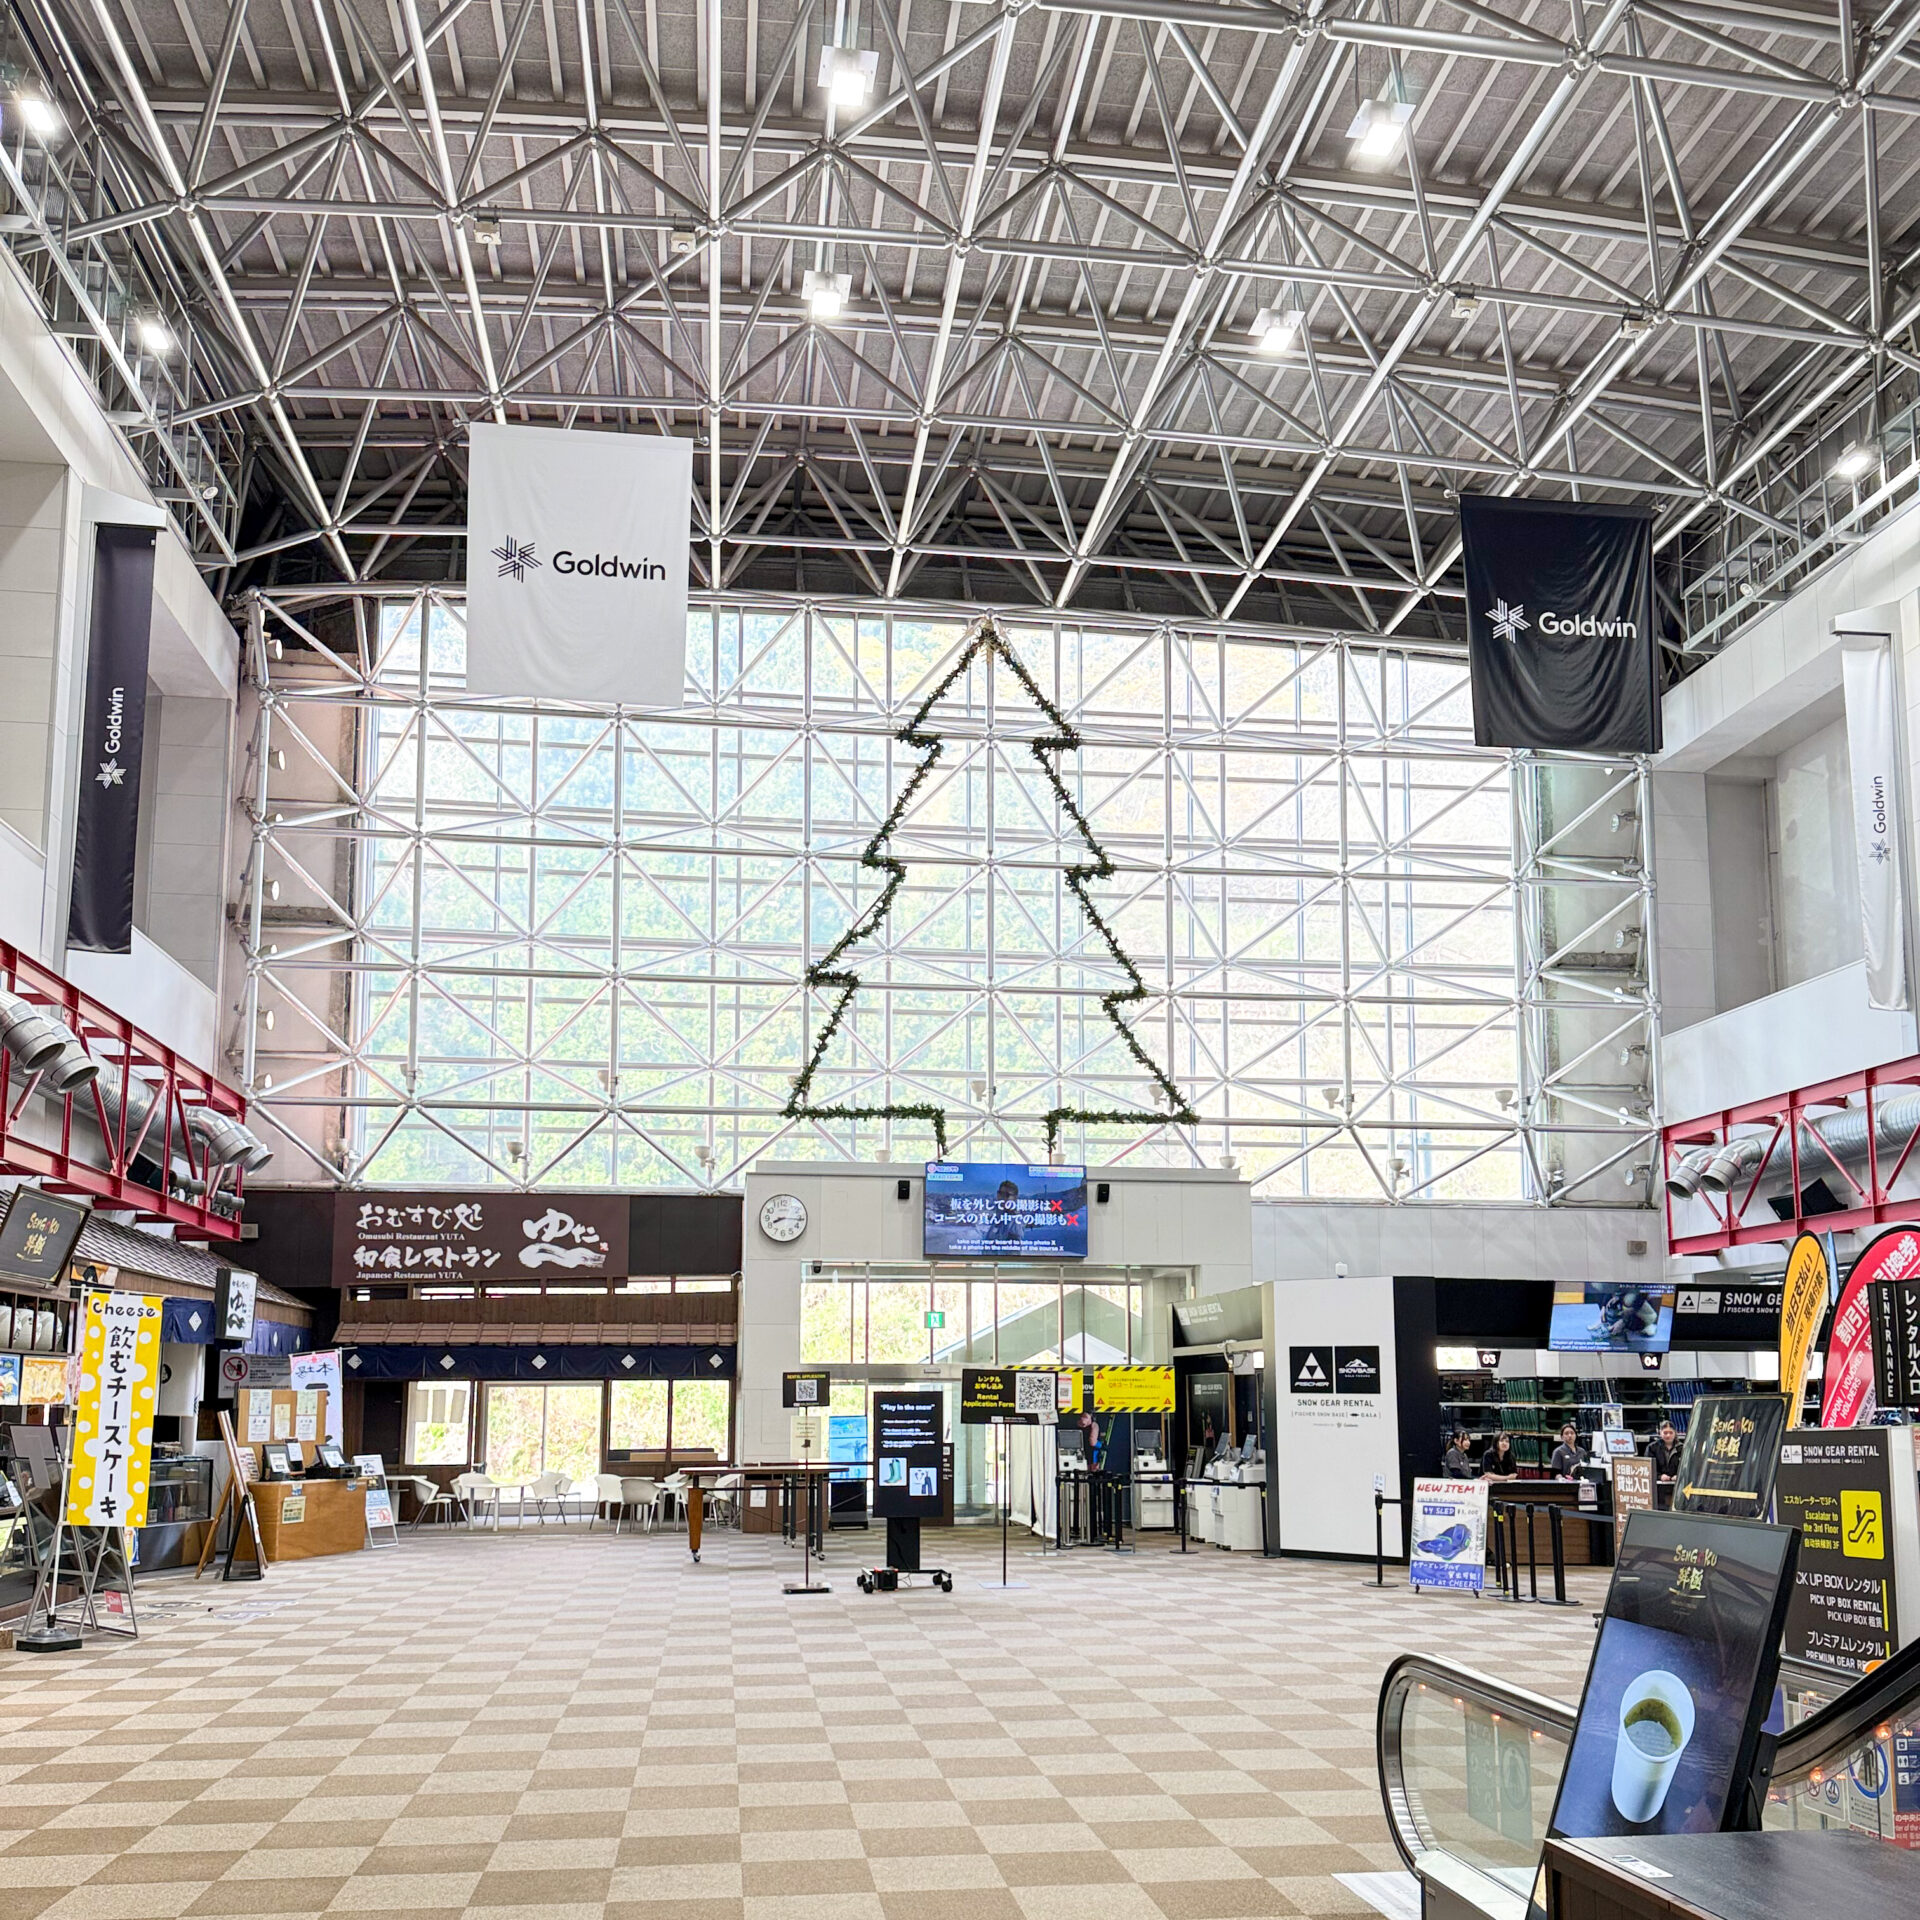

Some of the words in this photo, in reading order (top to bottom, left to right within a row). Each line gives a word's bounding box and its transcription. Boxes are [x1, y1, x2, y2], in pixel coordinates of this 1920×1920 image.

[553, 549, 667, 582] Goldwin
[1538, 611, 1637, 640] Goldwin
[103, 686, 124, 755] Goldwin
[1873, 775, 1884, 834] Goldwin
[355, 1203, 484, 1231] おむすび処
[358, 1232, 394, 1241] Omusubi
[395, 1232, 438, 1241] Restaurant
[440, 1233, 466, 1241] YUTA
[353, 1245, 501, 1269] 和食レストラン
[356, 1271, 392, 1280] Japanese
[394, 1271, 436, 1280] Restaurant
[438, 1271, 464, 1279] YUTA
[1724, 1292, 1763, 1305] SNOW
[1882, 1287, 1894, 1398] ENTRANCE
[1904, 1289, 1920, 1396] レンタル入口
[1481, 1353, 1497, 1365] 03
[1643, 1356, 1658, 1367] 04
[977, 1375, 1001, 1383] レンタル
[976, 1393, 999, 1401] Rental
[1826, 1396, 1844, 1429] OUPON
[1842, 1350, 1866, 1390] VOUCHER
[963, 1400, 998, 1409] Application
[1320, 1399, 1341, 1407] GEAR
[1343, 1400, 1375, 1408] RENTAL
[1840, 1377, 1862, 1420] HOLDERS
[99, 1325, 136, 1519] 飲むチーズケーキ
[1803, 1445, 1823, 1457] SNOW
[1825, 1446, 1846, 1457] GEAR
[1847, 1445, 1880, 1457] RENTAL
[1416, 1483, 1443, 1492] NEW
[1444, 1484, 1475, 1494] ITEM
[1616, 1475, 1650, 1493] 貸出入口
[1783, 1495, 1838, 1506] エスカレーターで3Fへ
[1435, 1506, 1455, 1515] SLED
[1804, 1510, 1831, 1522] Escalator
[1832, 1512, 1839, 1522] to
[1803, 1523, 1813, 1532] the
[1813, 1524, 1823, 1533] 3rd
[1824, 1524, 1839, 1534] Floor
[1412, 1576, 1436, 1585] Rental
[1437, 1578, 1447, 1586] at
[1448, 1579, 1481, 1589] CHEERS!
[1809, 1572, 1823, 1587] UP
[1824, 1574, 1844, 1590] BOX
[1846, 1576, 1881, 1594] レンタル
[1809, 1593, 1826, 1606] PICK
[1826, 1595, 1836, 1606] UP
[1837, 1597, 1852, 1610] BOX
[1853, 1599, 1882, 1613] RENTAL
[1827, 1610, 1842, 1621] PICK
[1843, 1612, 1853, 1623] UP
[1853, 1614, 1868, 1625] BOX
[1807, 1630, 1885, 1657] プレミアムレンタル
[1805, 1649, 1835, 1665] PREMIUM
[1836, 1655, 1856, 1668] GEAR
